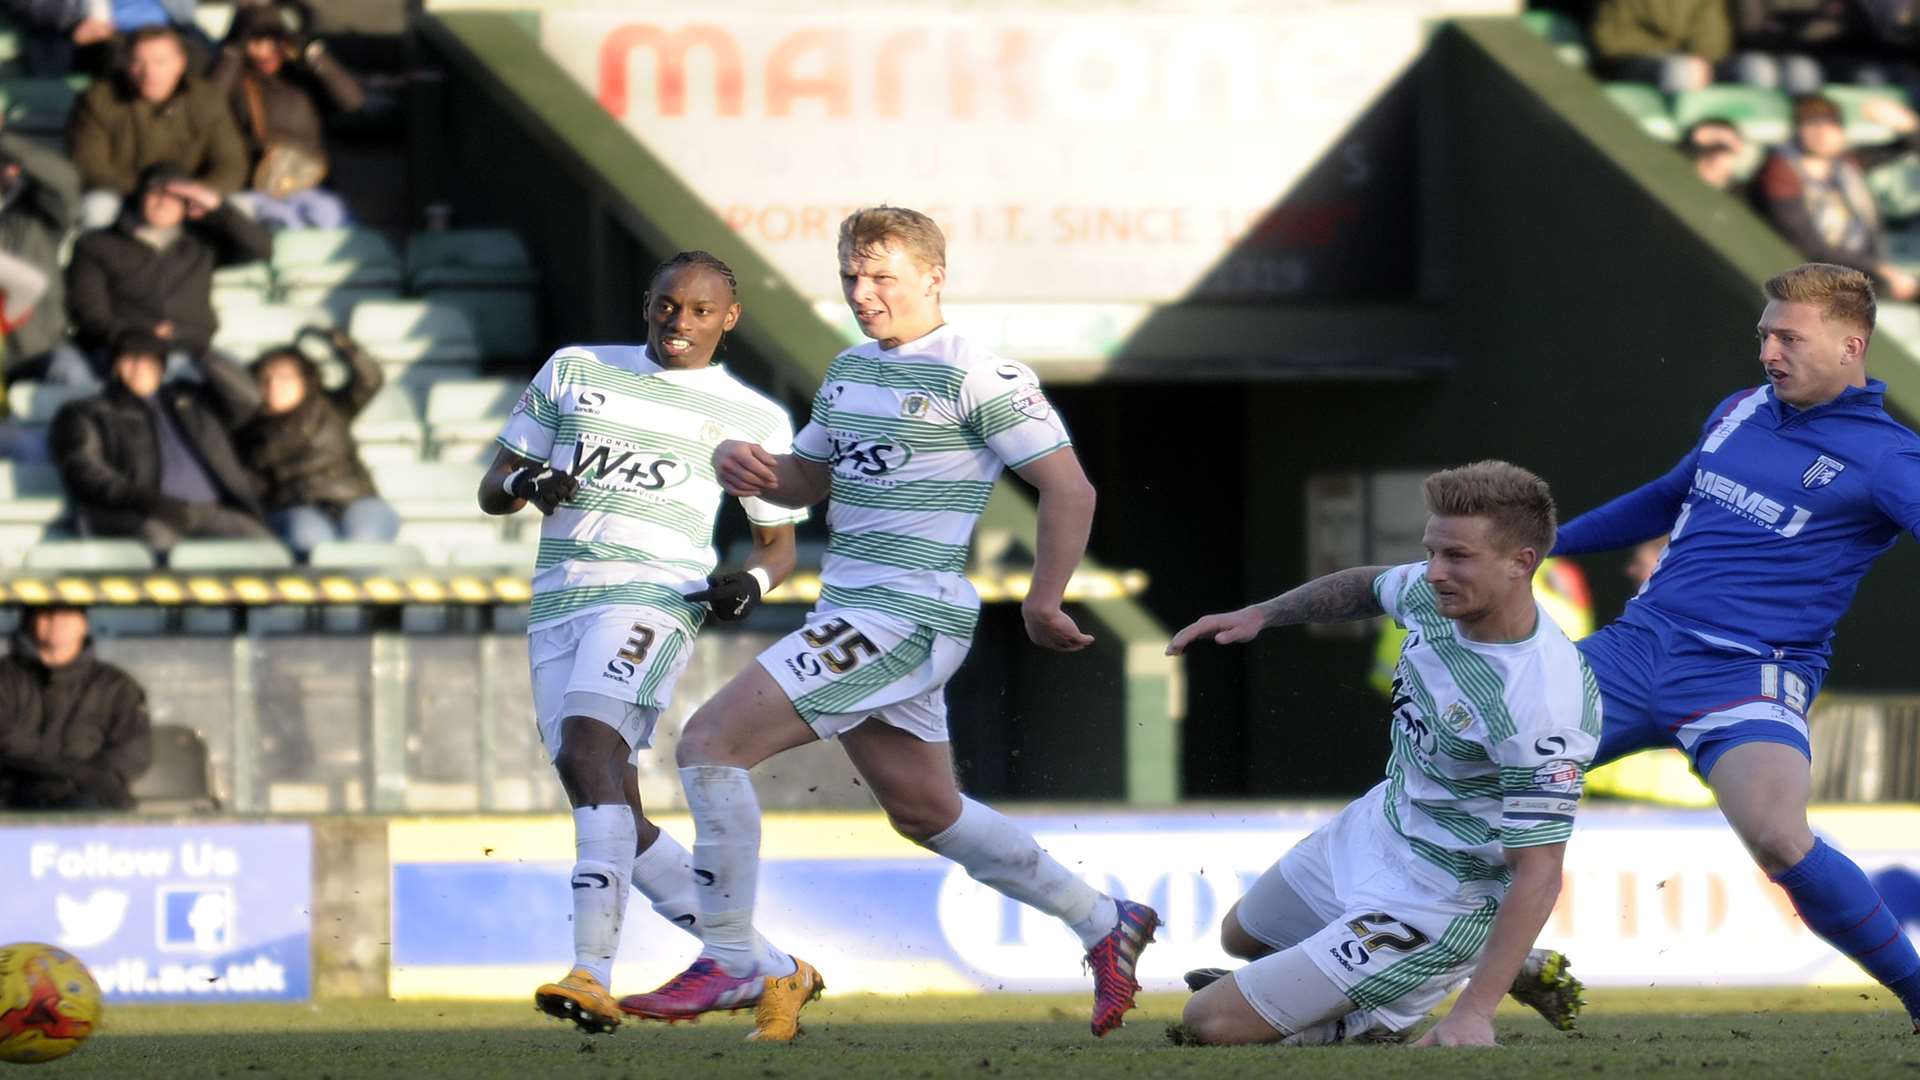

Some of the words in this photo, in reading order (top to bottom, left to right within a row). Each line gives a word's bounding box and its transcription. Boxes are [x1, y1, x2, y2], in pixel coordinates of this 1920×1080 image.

[1054, 206, 1195, 246] SINCE
[578, 433, 638, 451] NATIONAL
[571, 441, 677, 490] W+S
[1695, 468, 1785, 526] MEMS
[616, 622, 655, 665] 3
[801, 617, 880, 675] 35
[30, 842, 173, 878] Follow
[181, 839, 239, 876] Us
[1345, 912, 1430, 955] 27
